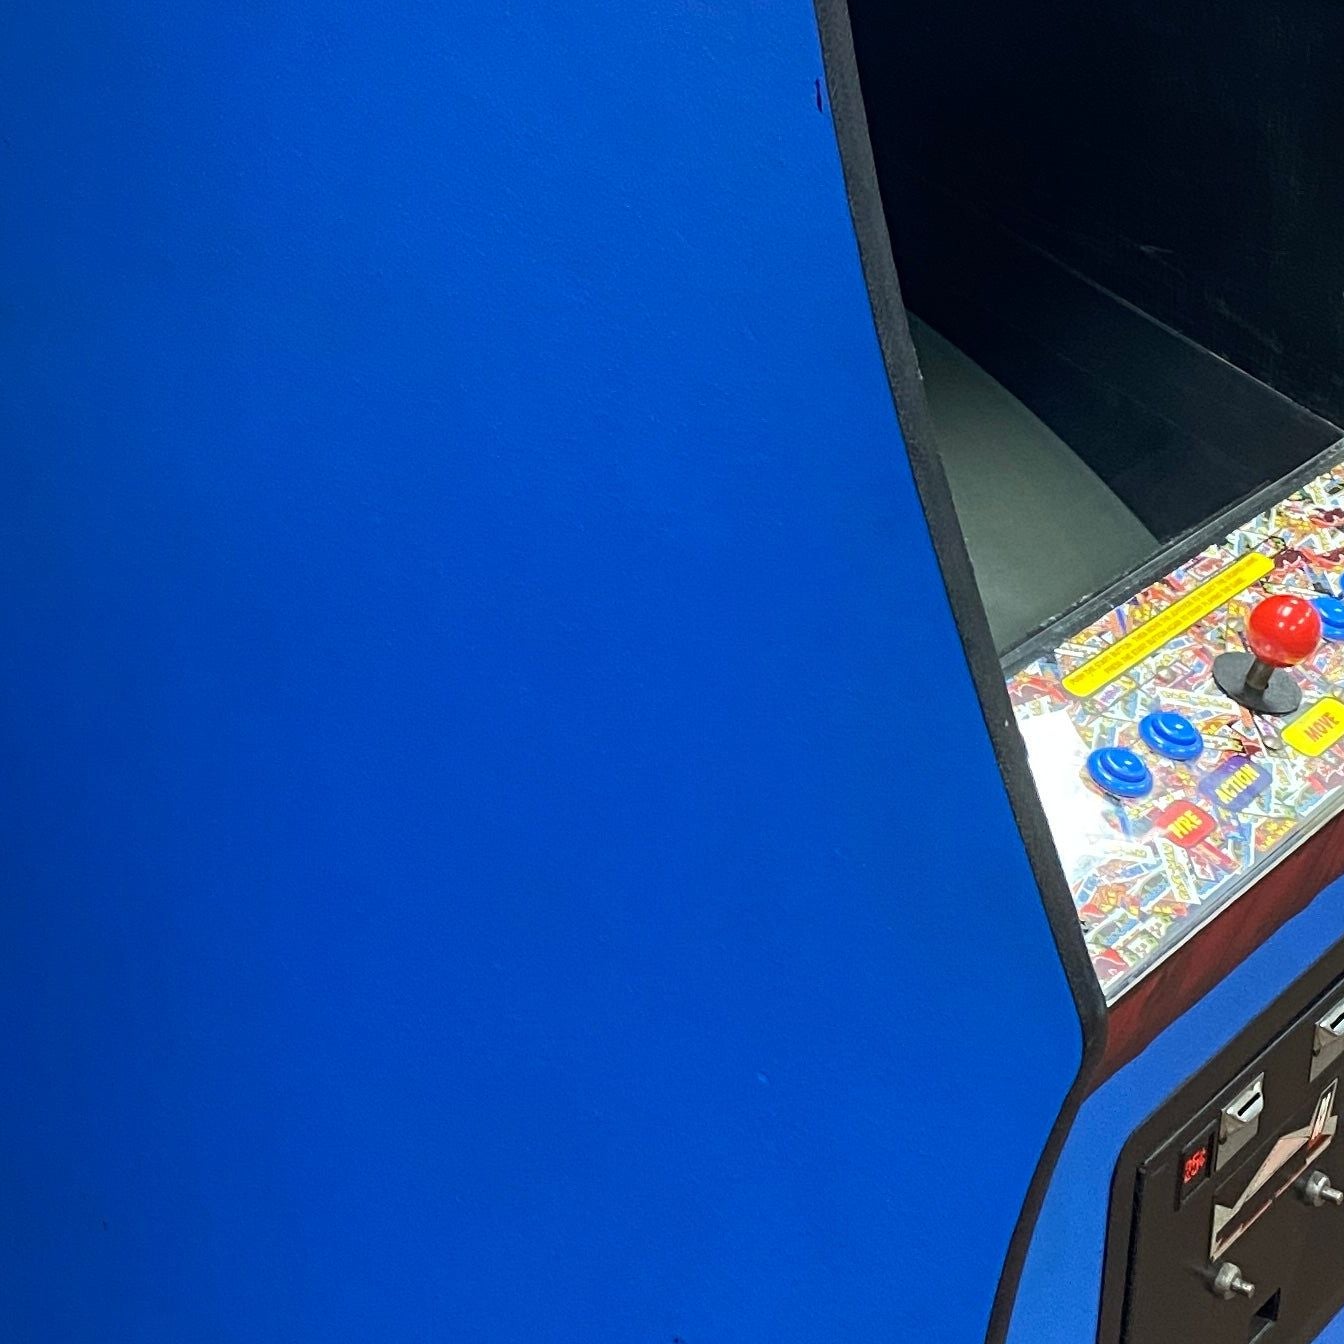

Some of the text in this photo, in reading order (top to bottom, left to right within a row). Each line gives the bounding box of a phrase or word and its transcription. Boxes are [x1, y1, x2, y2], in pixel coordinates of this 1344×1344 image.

[1303, 711, 1340, 743] MOVE
[1214, 762, 1261, 805] ACTION
[1166, 808, 1204, 840] FIRE
